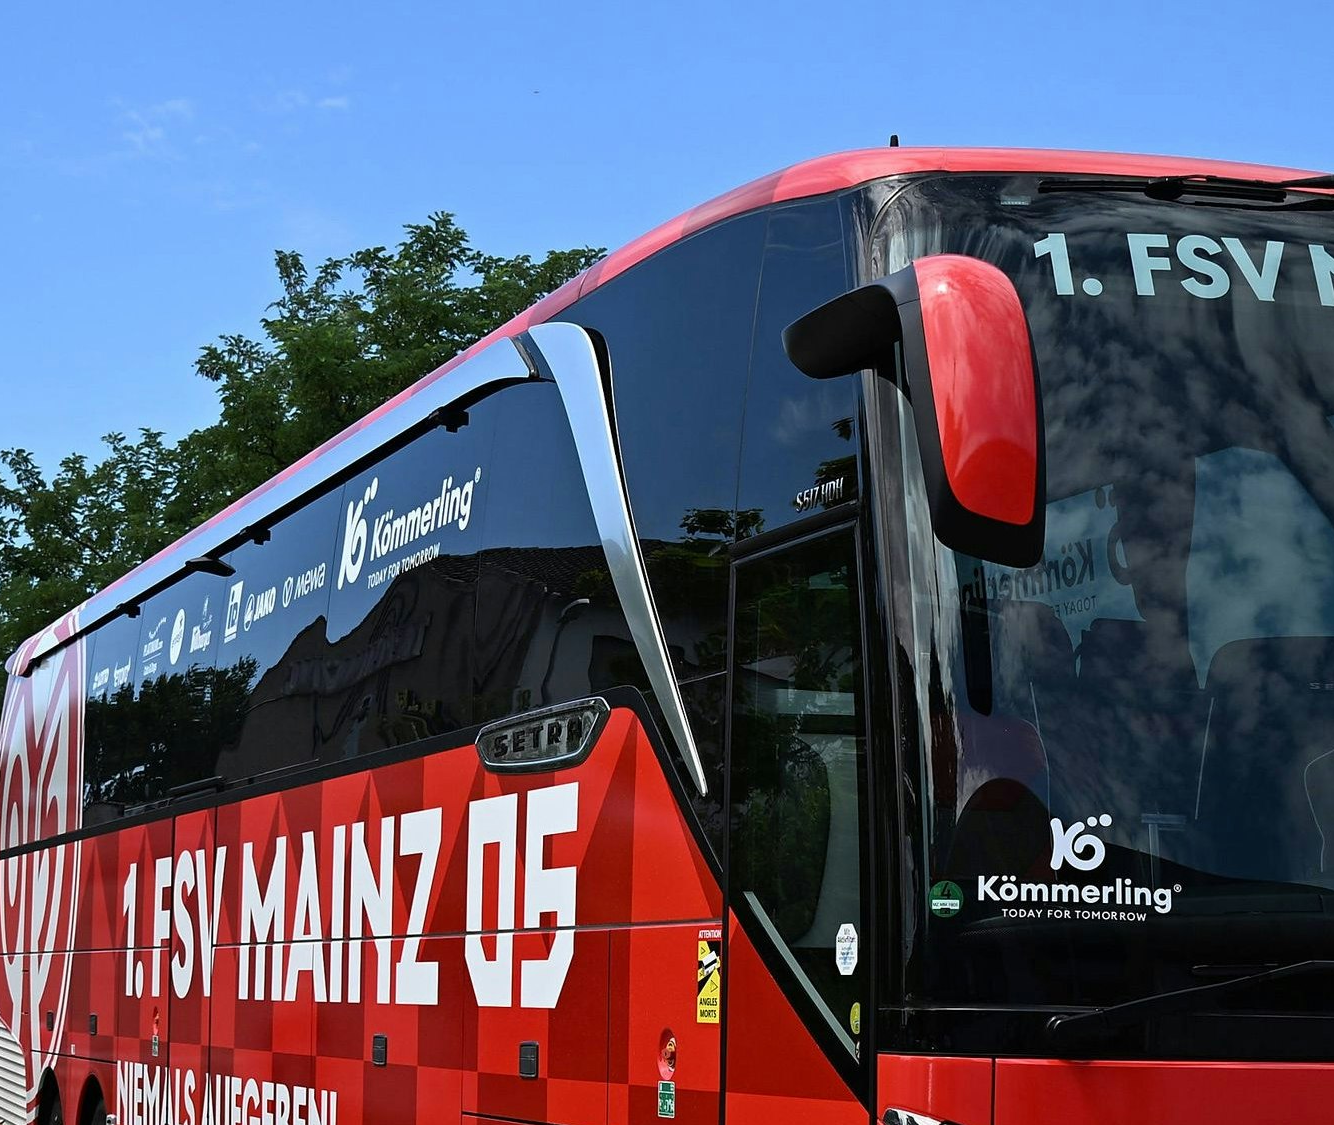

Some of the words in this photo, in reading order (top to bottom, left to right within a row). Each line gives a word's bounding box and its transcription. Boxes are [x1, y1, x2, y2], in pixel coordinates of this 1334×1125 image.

[1034, 233, 1103, 296] 1.
[1127, 233, 1284, 302] FSV
[368, 570, 387, 589] TODAY
[388, 562, 400, 580] FOR
[401, 542, 440, 573] TOMORROW
[254, 587, 276, 622] JAKO
[494, 715, 583, 758] SETRA
[123, 862, 145, 999] 1.
[151, 845, 227, 999] FSV
[238, 807, 442, 1005] MAINZ
[464, 782, 579, 1008] 05
[1002, 909, 1043, 918] TODAY
[1047, 910, 1071, 919] FOR
[1076, 910, 1147, 922] TOMORROW
[698, 929, 722, 939] ATTENTION
[699, 997, 717, 1006] ANGLES
[699, 1009, 717, 1018] MORTS
